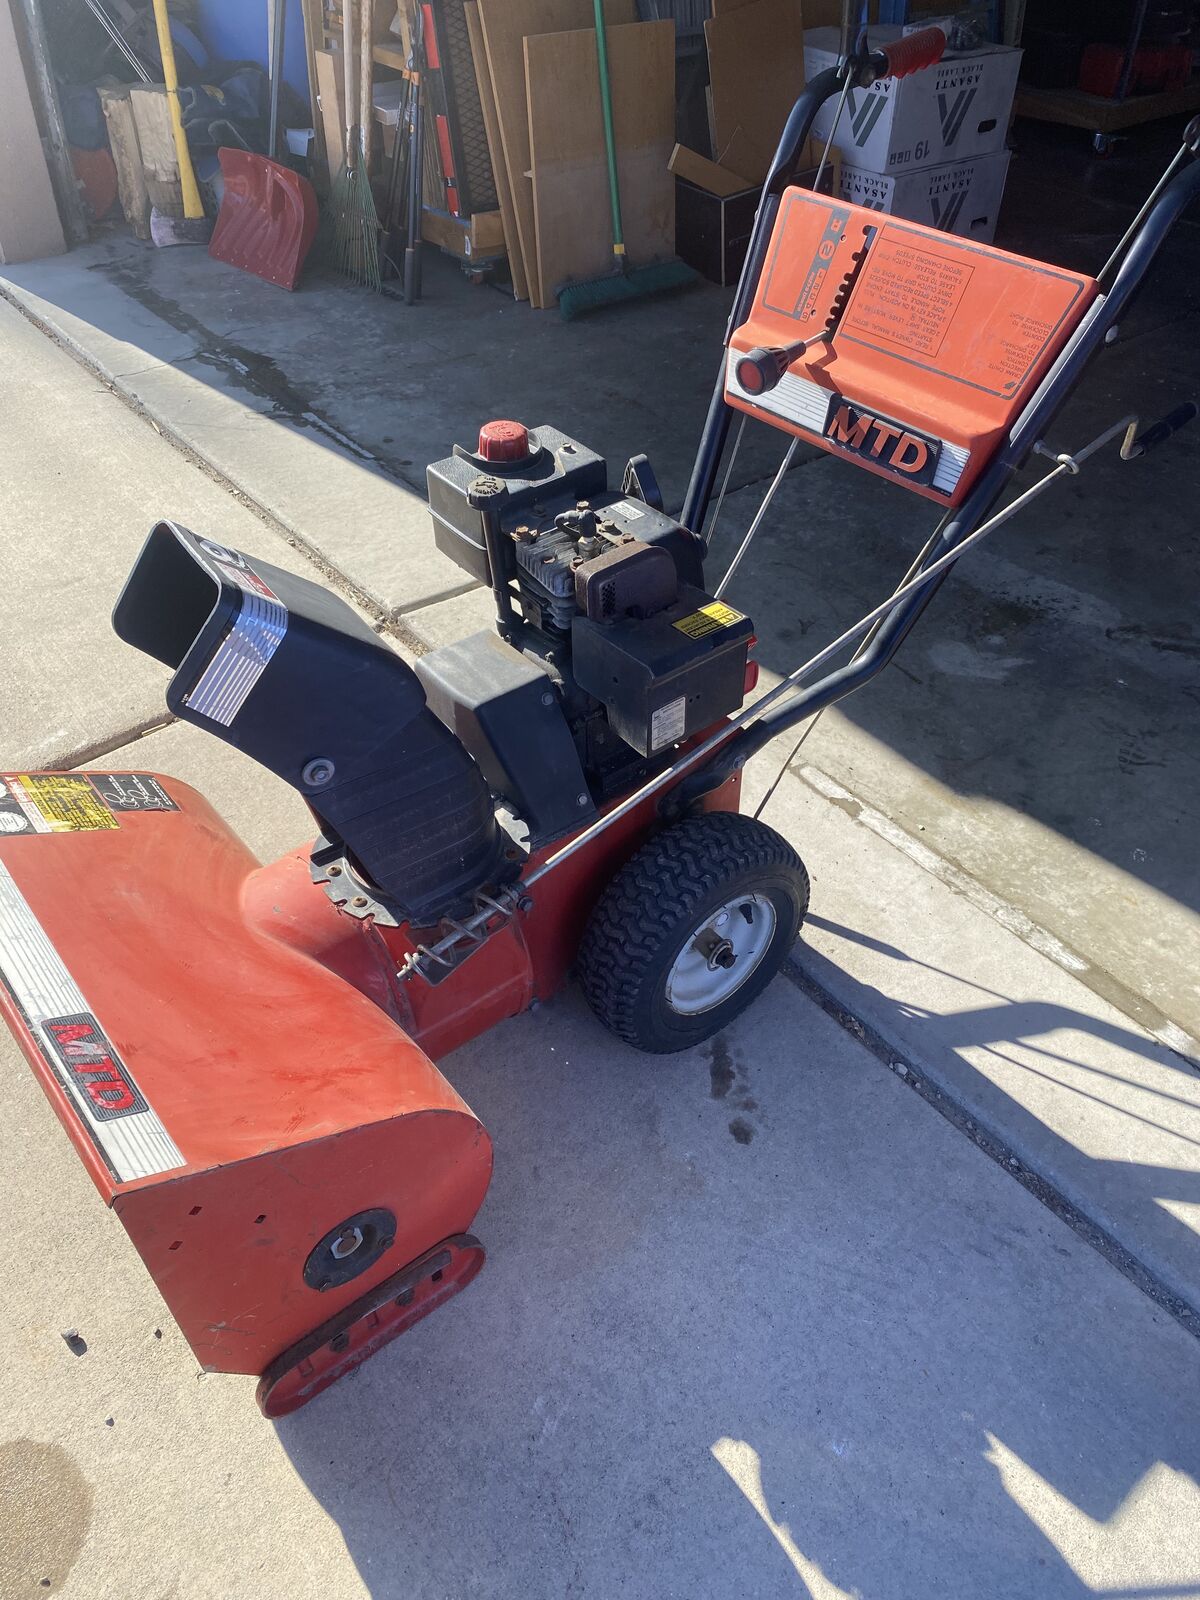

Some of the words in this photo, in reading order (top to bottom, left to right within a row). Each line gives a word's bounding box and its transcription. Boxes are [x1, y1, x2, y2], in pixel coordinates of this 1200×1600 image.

[935, 74, 982, 90] ASANTI
[914, 139, 930, 161] 19
[864, 175, 889, 189] BLACK
[928, 178, 972, 196] ASANTI
[891, 257, 912, 266] CLUTCH
[915, 256, 942, 268] CHANGING
[913, 264, 936, 274] RELEASE
[942, 265, 962, 274] BEFORE
[916, 273, 929, 281] STOP
[938, 272, 959, 282] ALWAYS
[916, 282, 937, 291] CLUTCH
[938, 281, 956, 289] LEASE
[910, 298, 929, 307] HANDLE
[929, 295, 949, 305] SELECT
[888, 314, 904, 322] LEVER
[926, 311, 942, 320] PLACE
[917, 317, 939, 327] NEUTRAL
[908, 331, 933, 341] STARTING
[1025, 341, 1039, 350] LEFT
[827, 406, 928, 474] MTD
[50, 1024, 136, 1110] MTD
